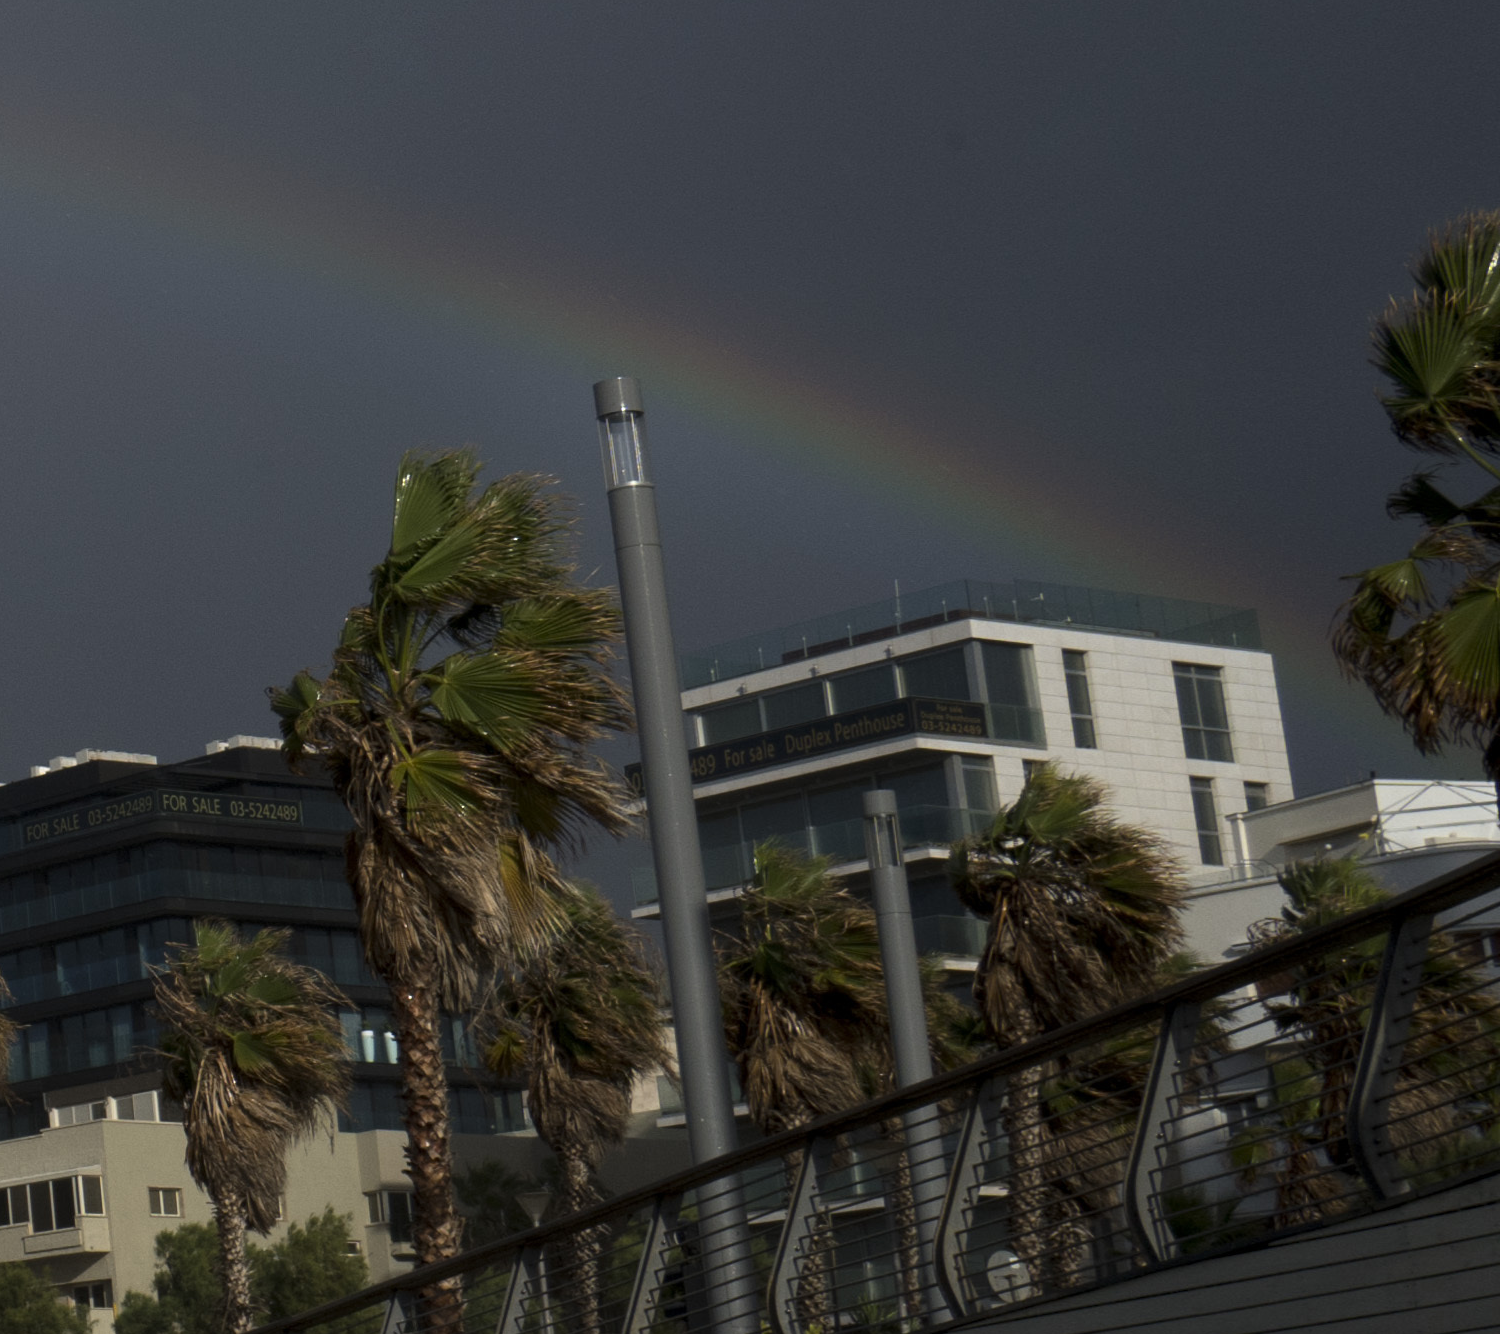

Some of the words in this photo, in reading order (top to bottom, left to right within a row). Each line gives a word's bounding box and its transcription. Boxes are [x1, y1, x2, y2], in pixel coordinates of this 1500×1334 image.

[724, 748, 746, 769] For
[749, 740, 776, 765] sale
[784, 729, 832, 755] Duplex
[834, 711, 905, 740] Penthouse
[921, 720, 982, 735] 03-5242489
[26, 822, 49, 842] FOR
[53, 814, 80, 834] SALE
[87, 795, 153, 827] 03-5242489
[163, 794, 187, 812] FOR
[192, 796, 221, 815] SALE
[230, 800, 298, 821] 03-5242489
